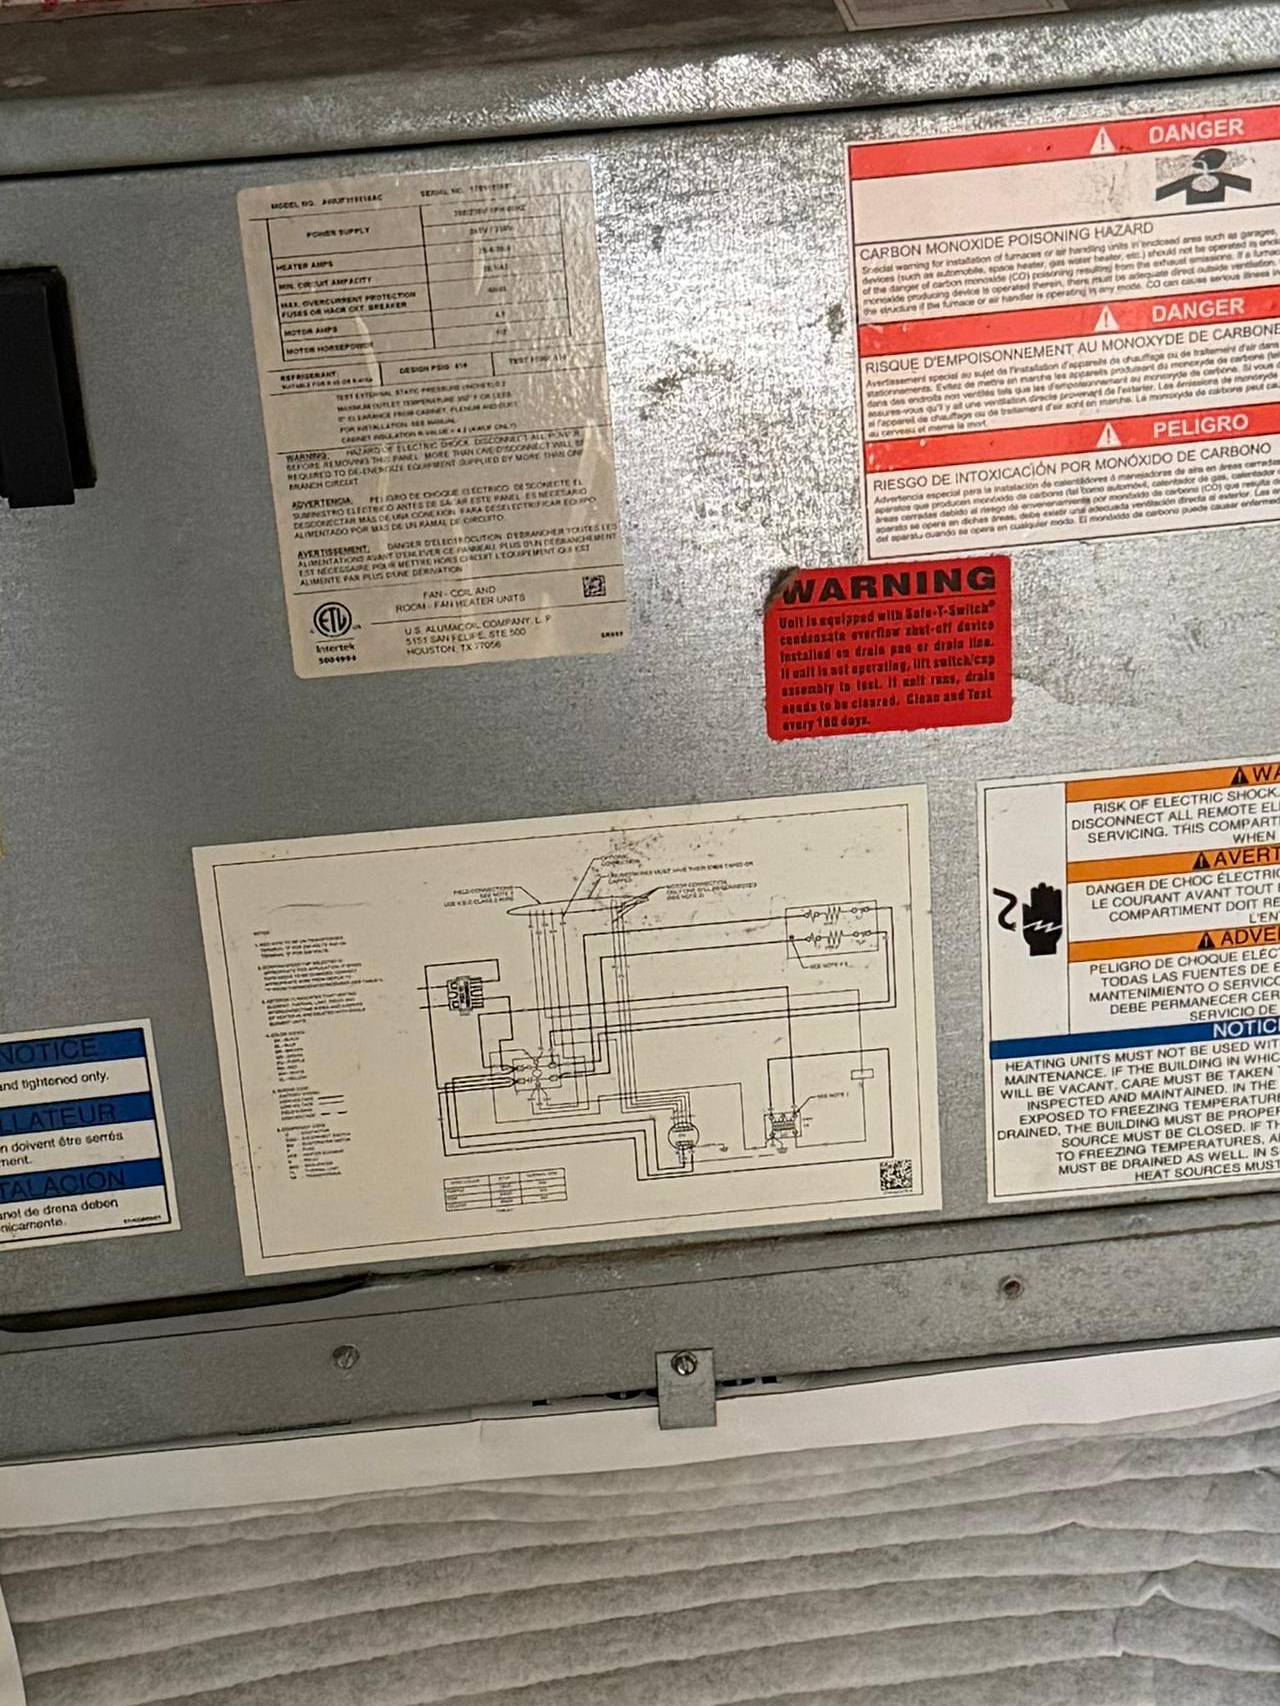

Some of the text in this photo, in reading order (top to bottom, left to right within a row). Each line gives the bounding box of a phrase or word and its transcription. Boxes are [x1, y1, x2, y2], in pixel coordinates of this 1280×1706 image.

[1148, 117, 1244, 144] DANGER
[858, 220, 1154, 261] CARBON MONOXIDE POISONING HAZARD
[1151, 296, 1244, 323] DANGER
[864, 356, 920, 374] RISQUE
[922, 341, 1074, 369] D'EMPOISONNEMENT
[1076, 339, 1098, 354] AU
[1100, 331, 1185, 351] MONOXYDE
[1187, 329, 1209, 344] DE
[1152, 412, 1249, 439] PELIGRO
[872, 441, 1272, 492] RIESGO DE INTOXICACIÓN POR MONÓXIDO DE CARBONO
[779, 565, 996, 606] WARNING
[1092, 800, 1126, 814] RISK
[1128, 797, 1149, 811] OF
[1152, 790, 1223, 809] ELECTRIC
[1231, 829, 1276, 844] WHEN
[1084, 876, 1145, 896] DANGER
[1148, 876, 1168, 891] DE
[1170, 873, 1213, 889] CHOC
[1088, 958, 1152, 976] PELIGRO
[1153, 956, 1173, 970] DE
[1176, 950, 1238, 967] CHOQUE
[1188, 1004, 1255, 1022] SERVICIO
[1257, 1003, 1277, 1016] DE
[1004, 1056, 1066, 1072] HEATING
[1068, 1052, 1111, 1067] UNITS
[1113, 1048, 1153, 1063] MUST
[1156, 1045, 1186, 1059] NOT
[1189, 1043, 1208, 1056] BE
[1211, 1040, 1250, 1055] USED
[1018, 1108, 1085, 1126] EXPOSED
[1087, 1106, 1108, 1119] TO
[1110, 1100, 1180, 1117] FREEZING
[10, 1137, 56, 1153] doivent
[1134, 1167, 1171, 1182] HEAT
[1173, 1161, 1241, 1178] SOURCES
[23, 1206, 40, 1217] de
